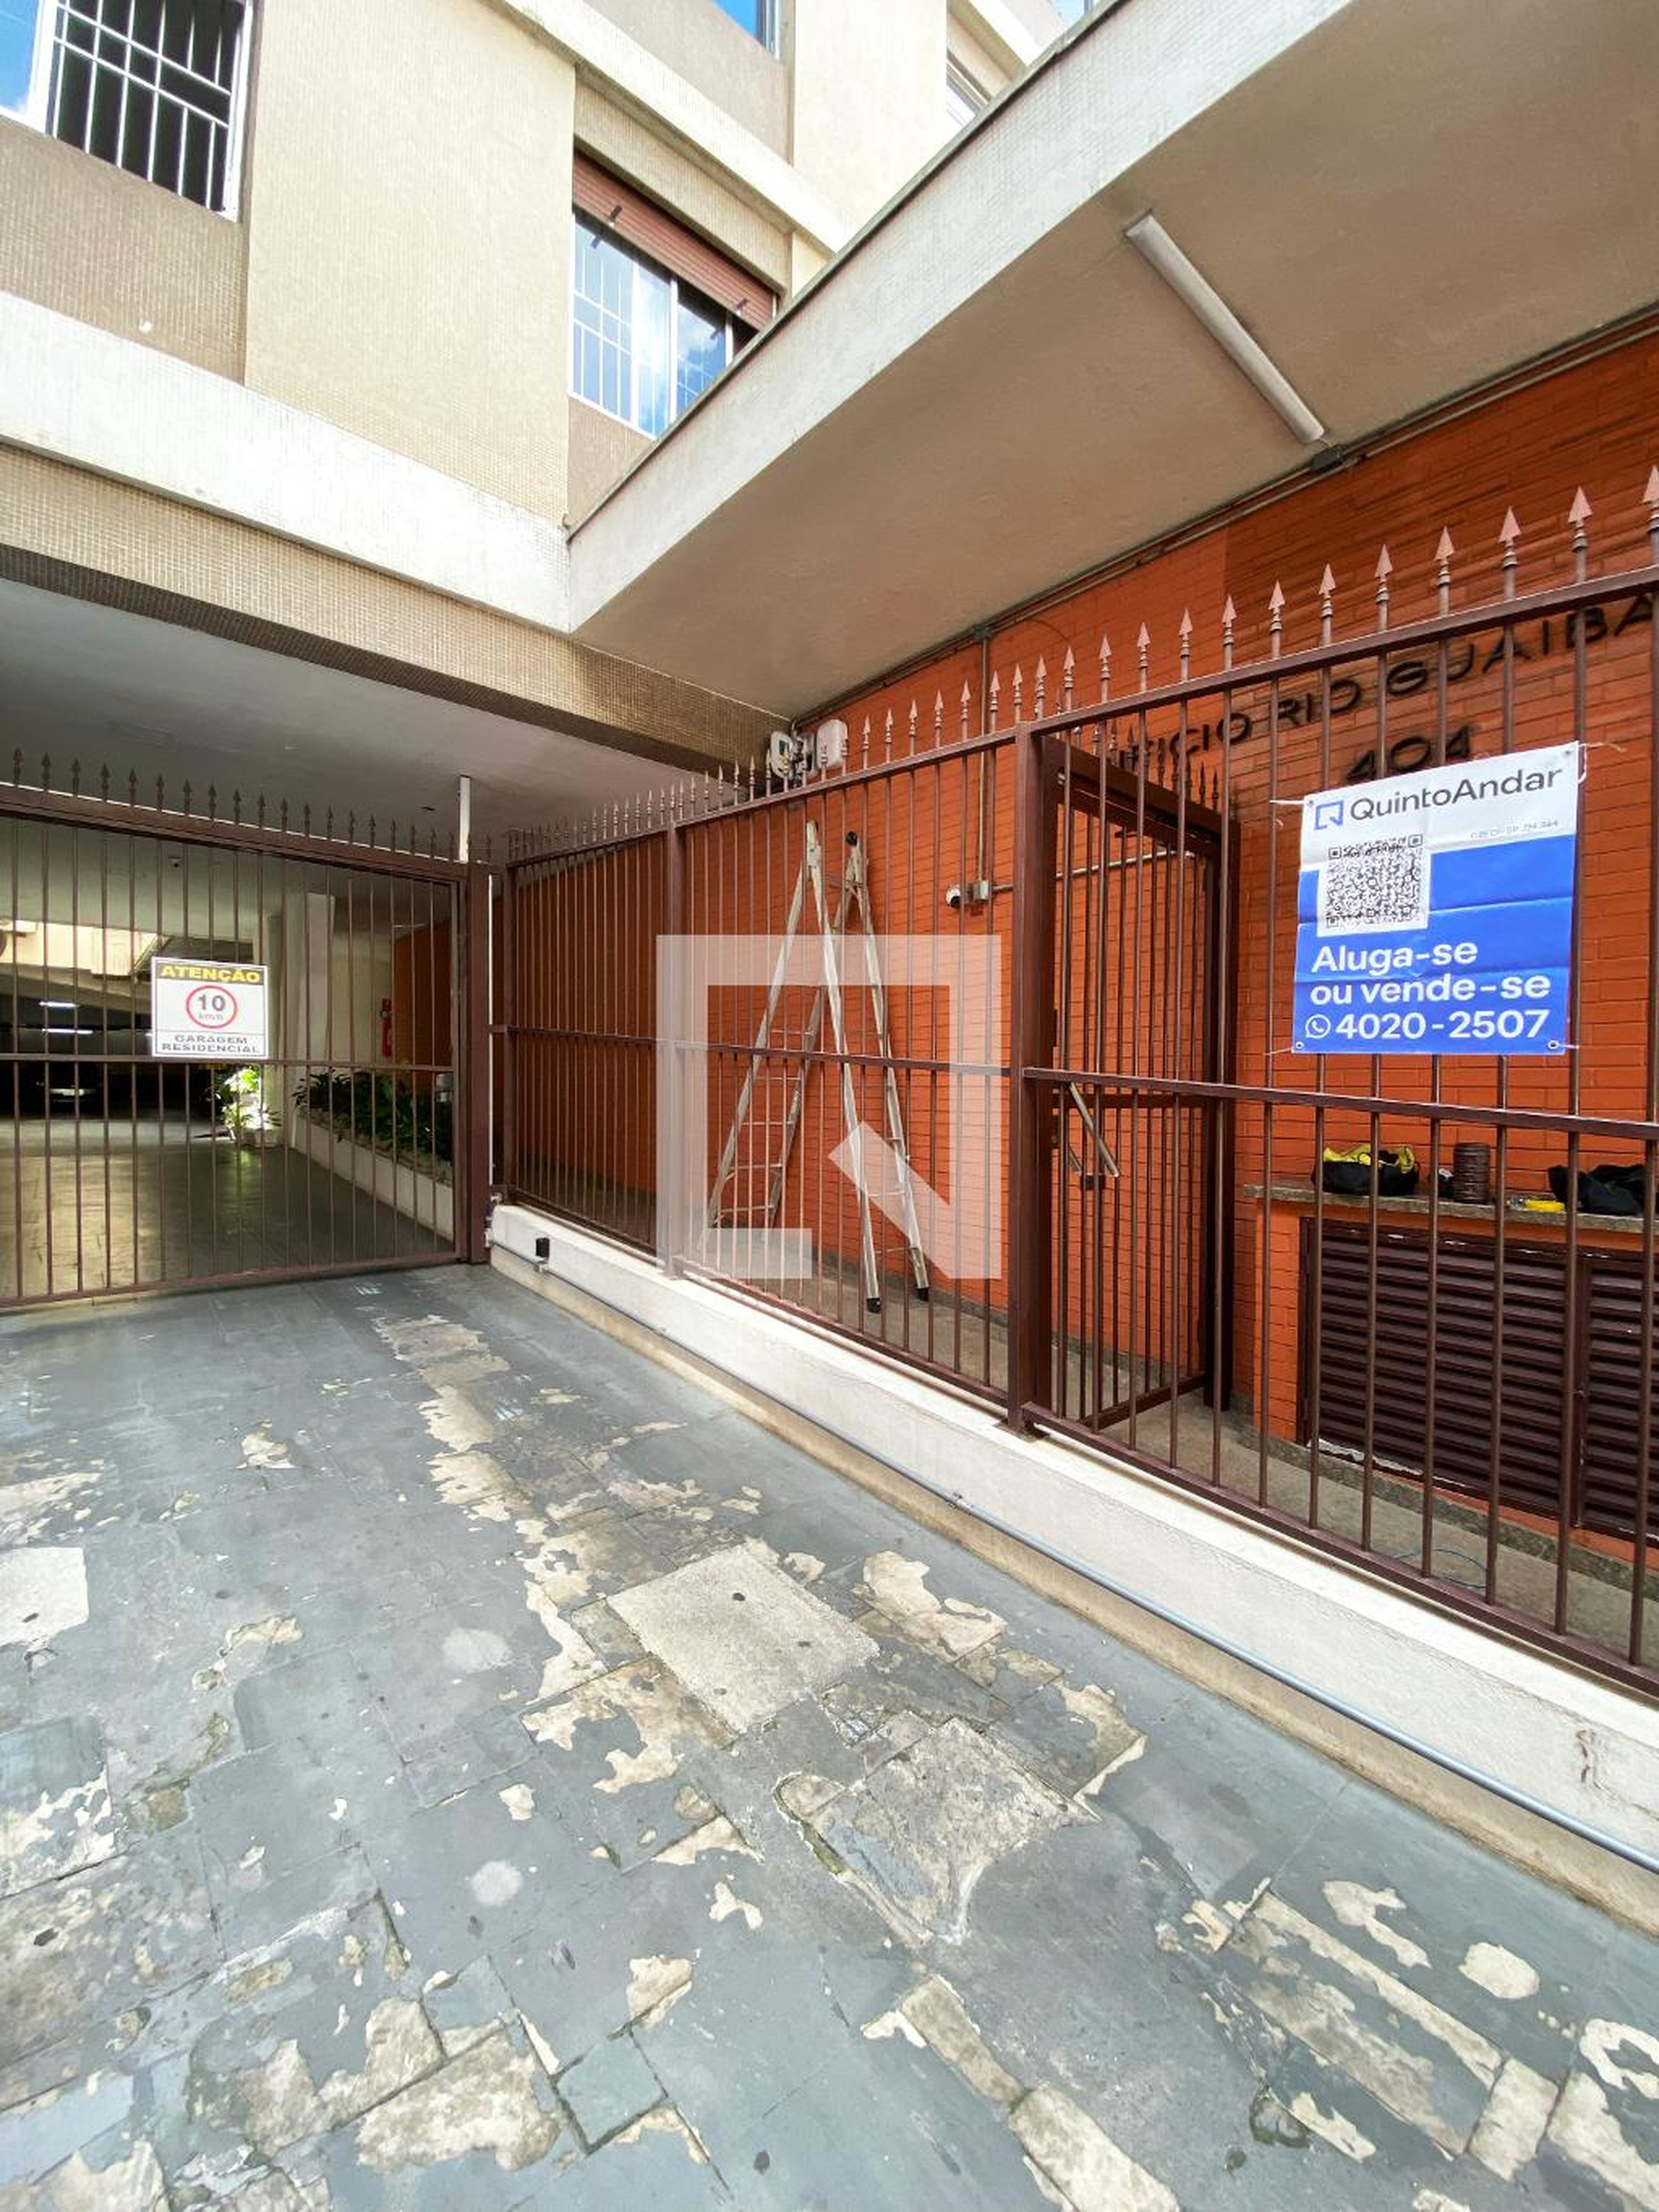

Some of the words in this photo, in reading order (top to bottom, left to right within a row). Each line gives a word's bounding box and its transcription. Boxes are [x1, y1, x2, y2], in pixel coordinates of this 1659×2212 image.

[1350, 768, 1563, 821] QuintoAndar
[1311, 941, 1478, 977] Aluga-se
[161, 964, 260, 983] ATENÇÃO
[1310, 984, 1352, 1005] ou
[1362, 973, 1551, 1003] vende-se
[198, 993, 226, 1012] 10
[1335, 1009, 1550, 1040] 4020-2507
[161, 1043, 260, 1053] RESIDENCIAL
[174, 1034, 247, 1044] GARAGEM
